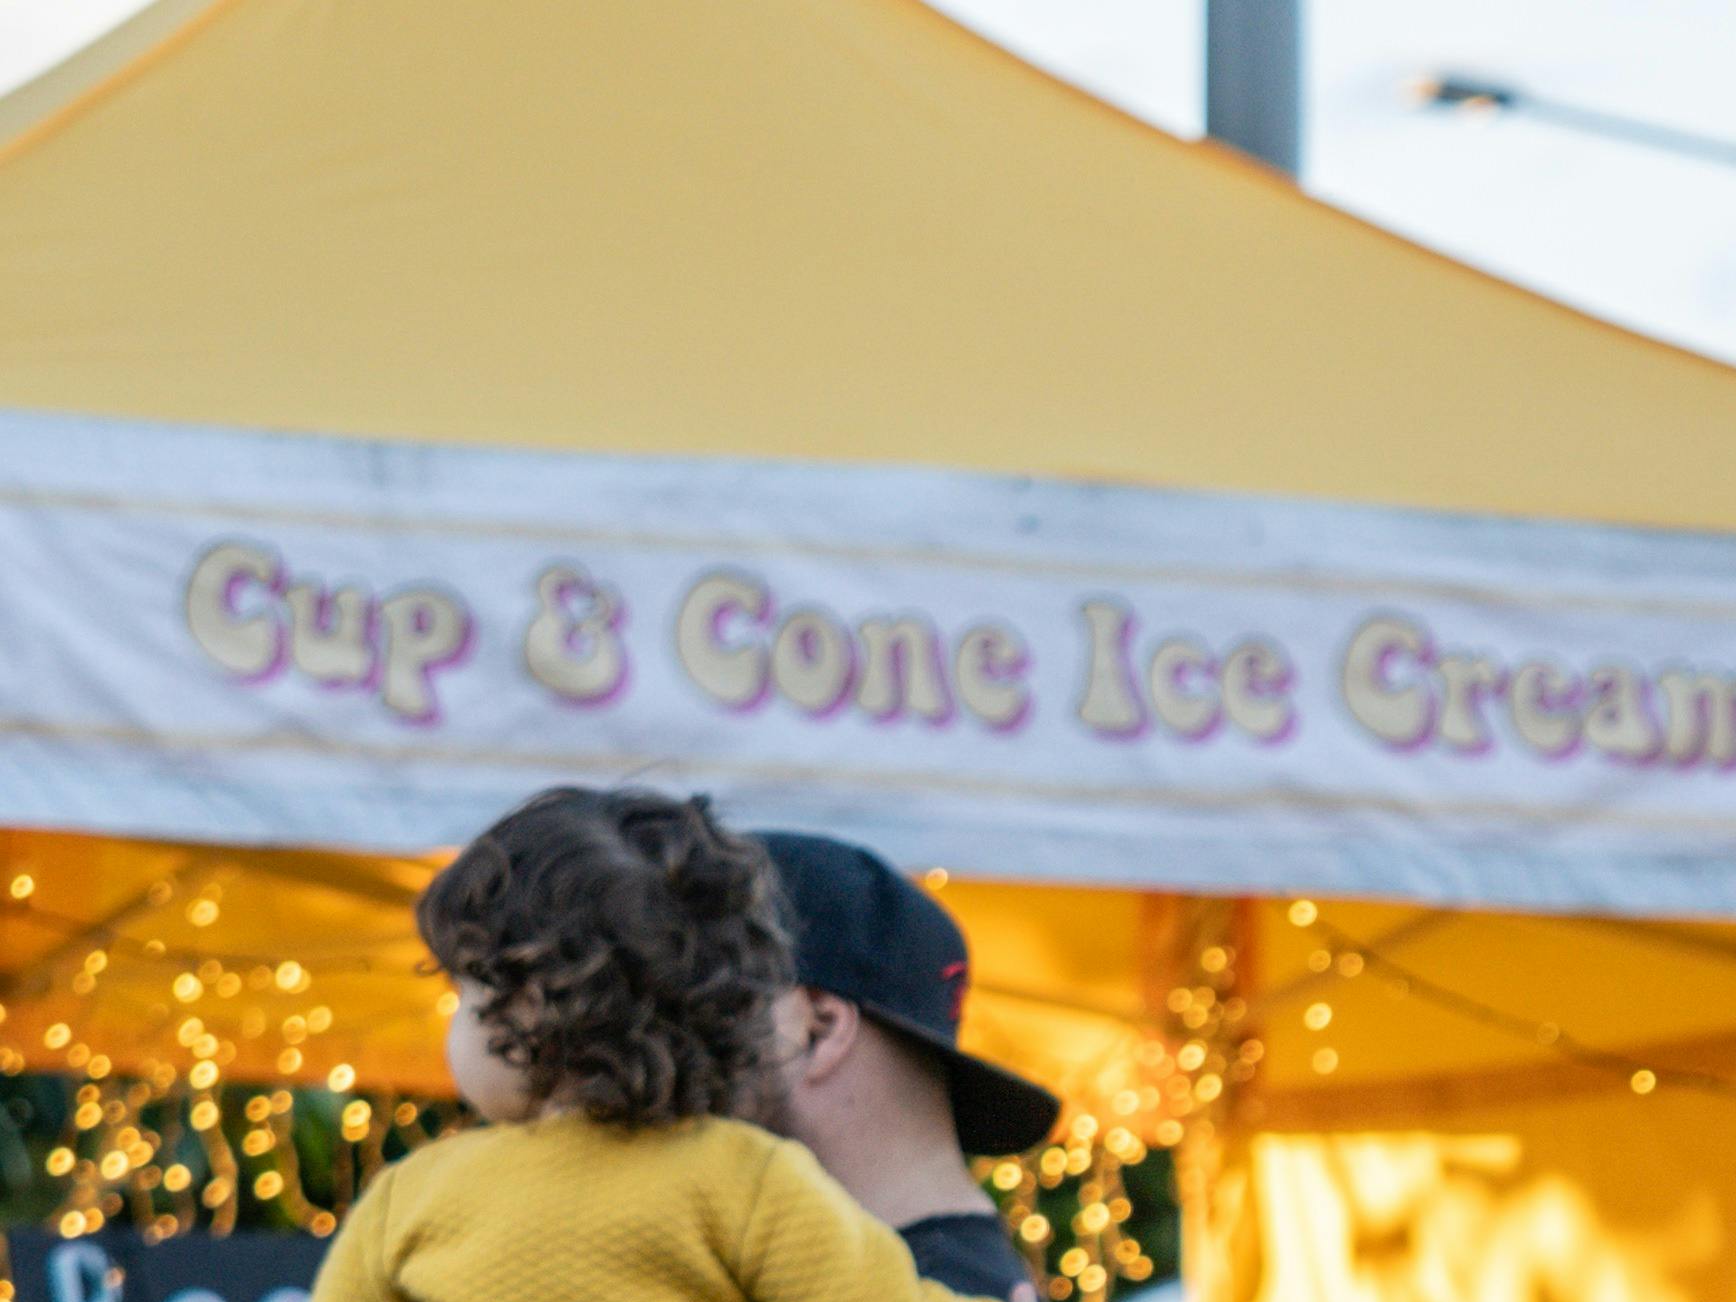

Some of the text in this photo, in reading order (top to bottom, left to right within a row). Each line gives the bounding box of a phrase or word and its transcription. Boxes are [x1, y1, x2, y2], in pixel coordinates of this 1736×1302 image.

[185, 539, 473, 723] Cup
[523, 565, 630, 705] &
[674, 568, 1034, 735] Cone
[1077, 599, 1296, 746] Ice
